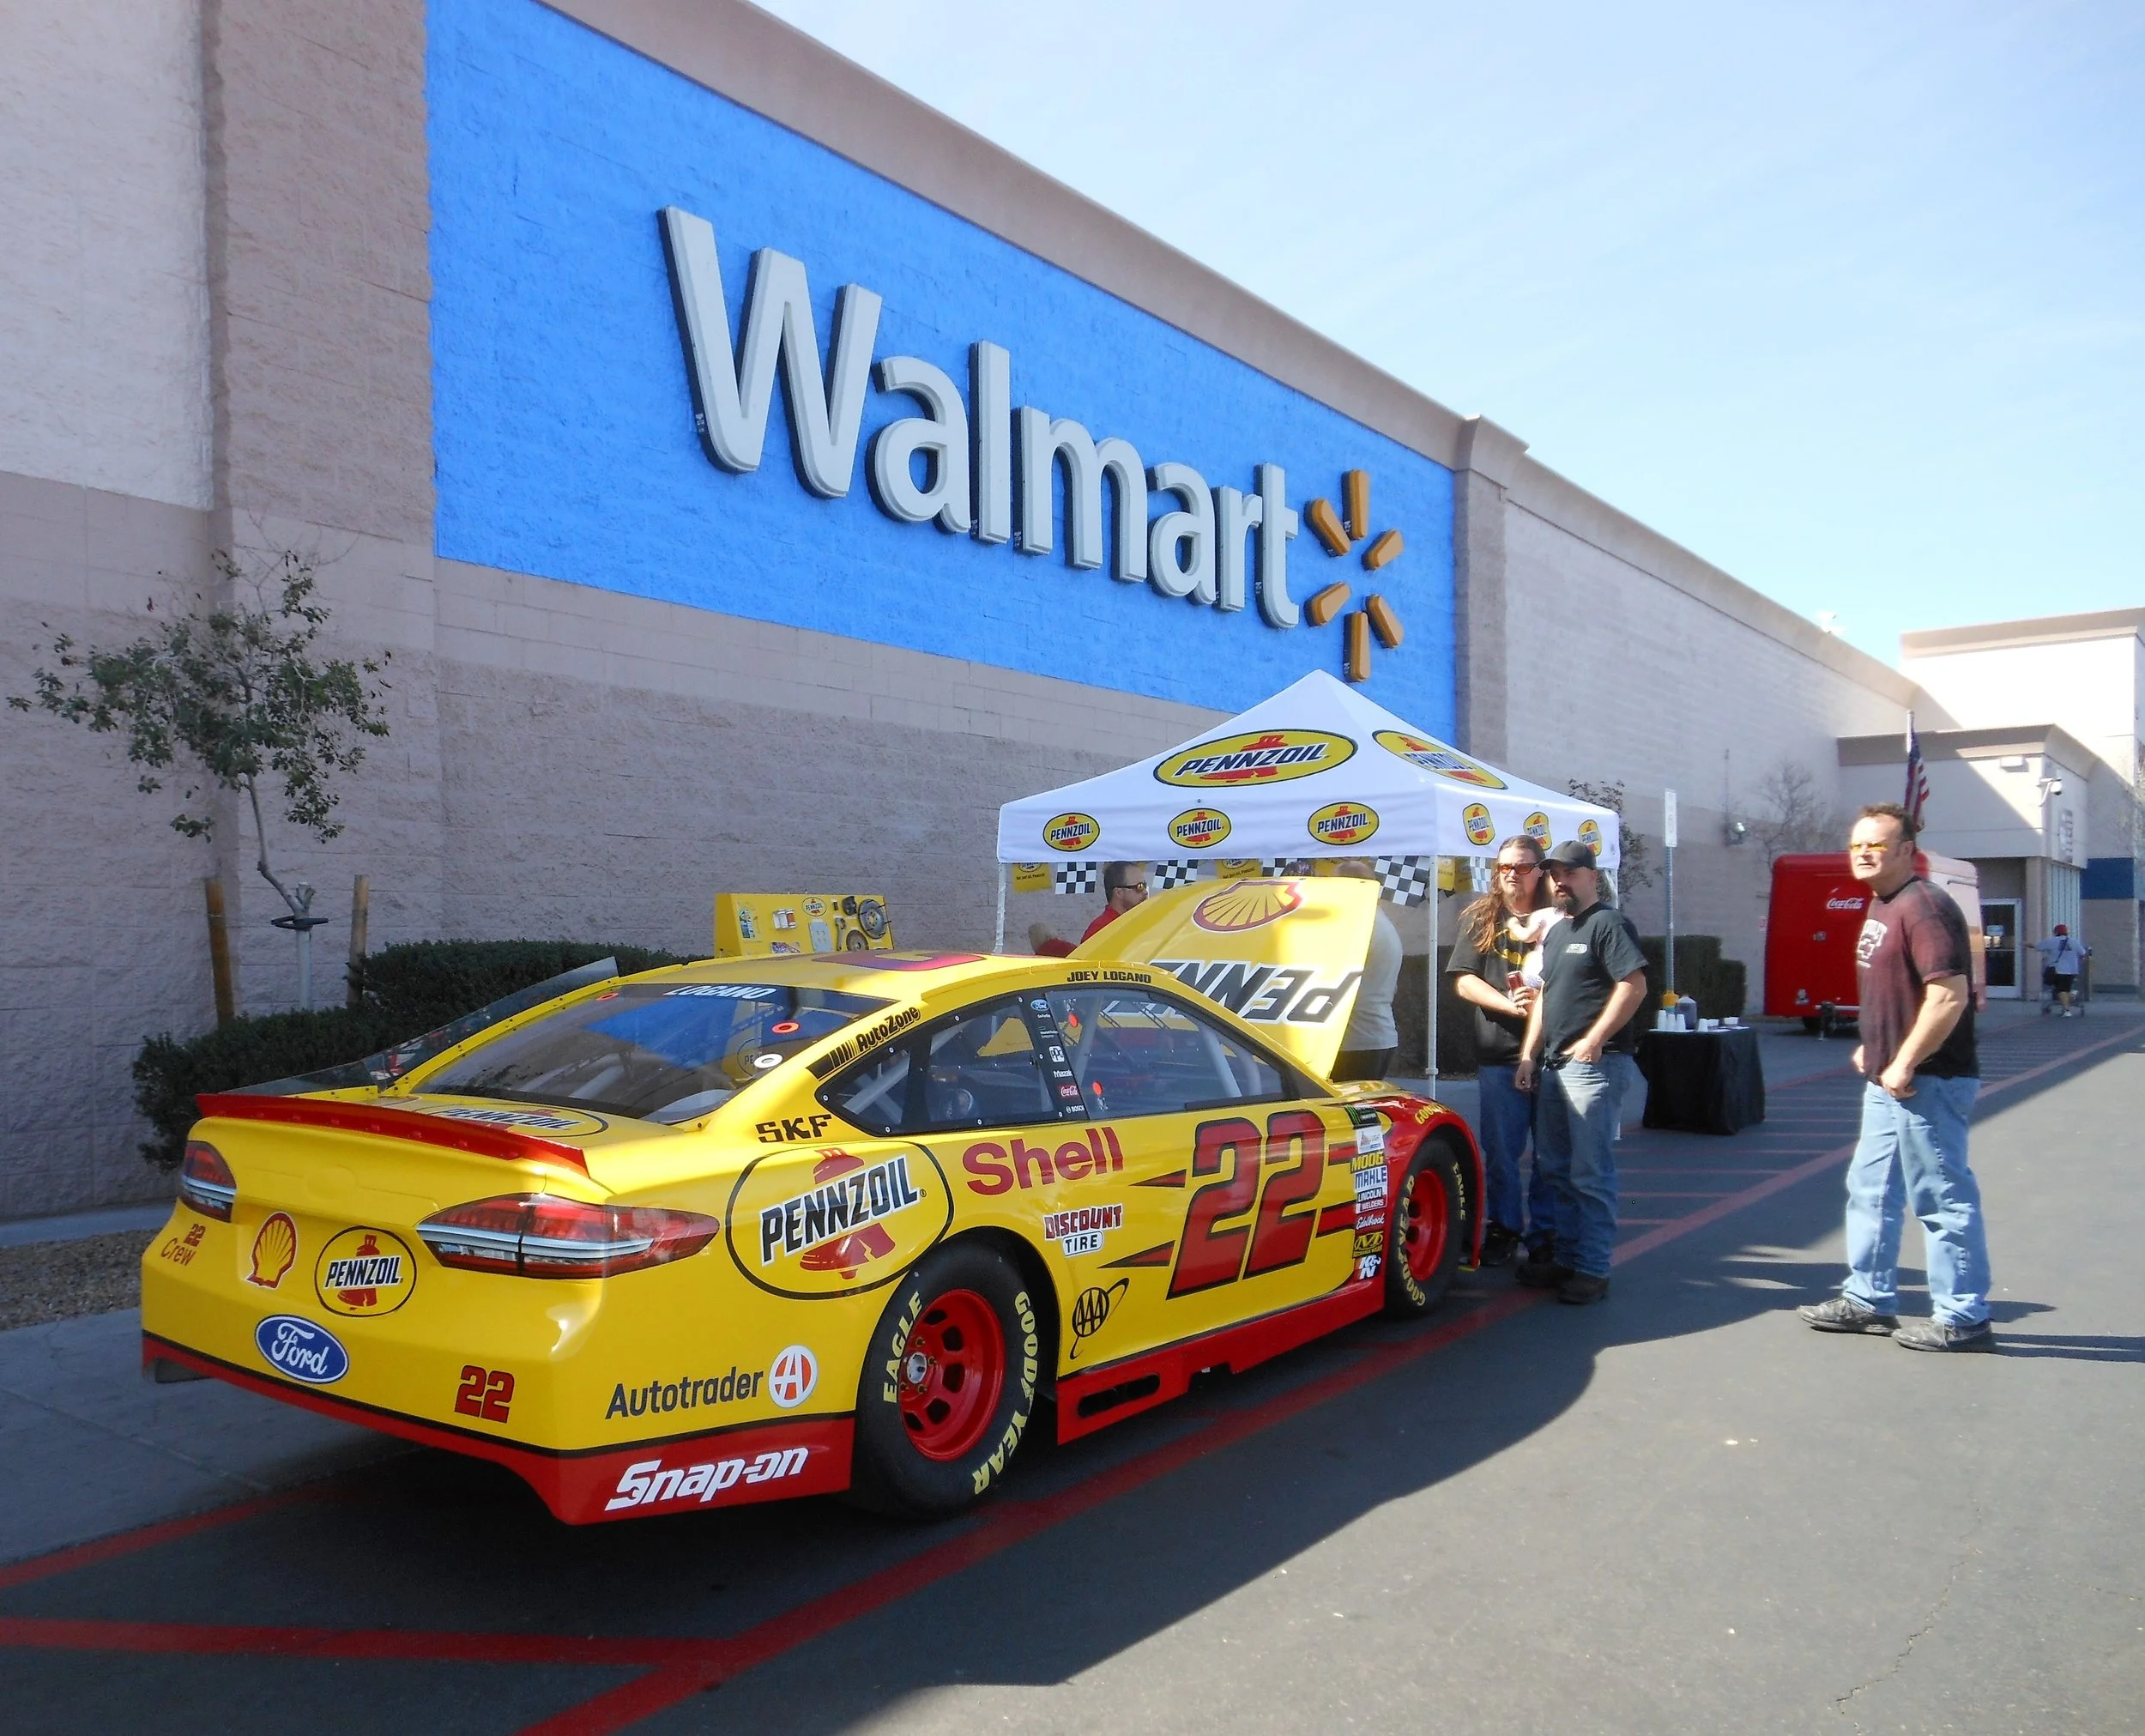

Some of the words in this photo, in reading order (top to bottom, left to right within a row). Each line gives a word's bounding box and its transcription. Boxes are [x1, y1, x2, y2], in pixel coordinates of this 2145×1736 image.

[658, 206, 1300, 629] Walmart
[1175, 743, 1329, 778] PENNZOIL
[1050, 825, 1093, 841] PENNZOIL
[1176, 818, 1223, 838] PENNZOIL
[1316, 812, 1370, 833] PENNZOIL
[662, 985, 777, 999] LOGANO
[1066, 971, 1100, 983] JOEY
[1103, 971, 1151, 984] LOGANO
[855, 1007, 921, 1053] AutoZone
[755, 1114, 831, 1144] SKF
[962, 1126, 1124, 1195] Shell
[1351, 1152, 1384, 1172] MOOG
[1355, 1167, 1387, 1189] MAHLE
[1166, 1108, 1326, 1300] 22
[1358, 1188, 1382, 1202] LINCOLN
[1362, 1199, 1385, 1210] WELDERS
[760, 1155, 922, 1267] PENNZOIL
[1044, 1205, 1122, 1240] DISCOUNT
[1356, 1213, 1385, 1230] Edelbrock
[184, 1223, 206, 1247] 22
[1065, 1234, 1098, 1254] TIRE
[160, 1237, 196, 1267] Crew
[323, 1255, 403, 1288] PENNZOIL
[1075, 1288, 1107, 1336] AAA
[271, 1322, 329, 1375] Ford
[883, 1291, 921, 1404] EAGLE
[454, 1365, 515, 1424] 22
[605, 1365, 764, 1421] Autotrader
[604, 1446, 809, 1512] Snap-on
